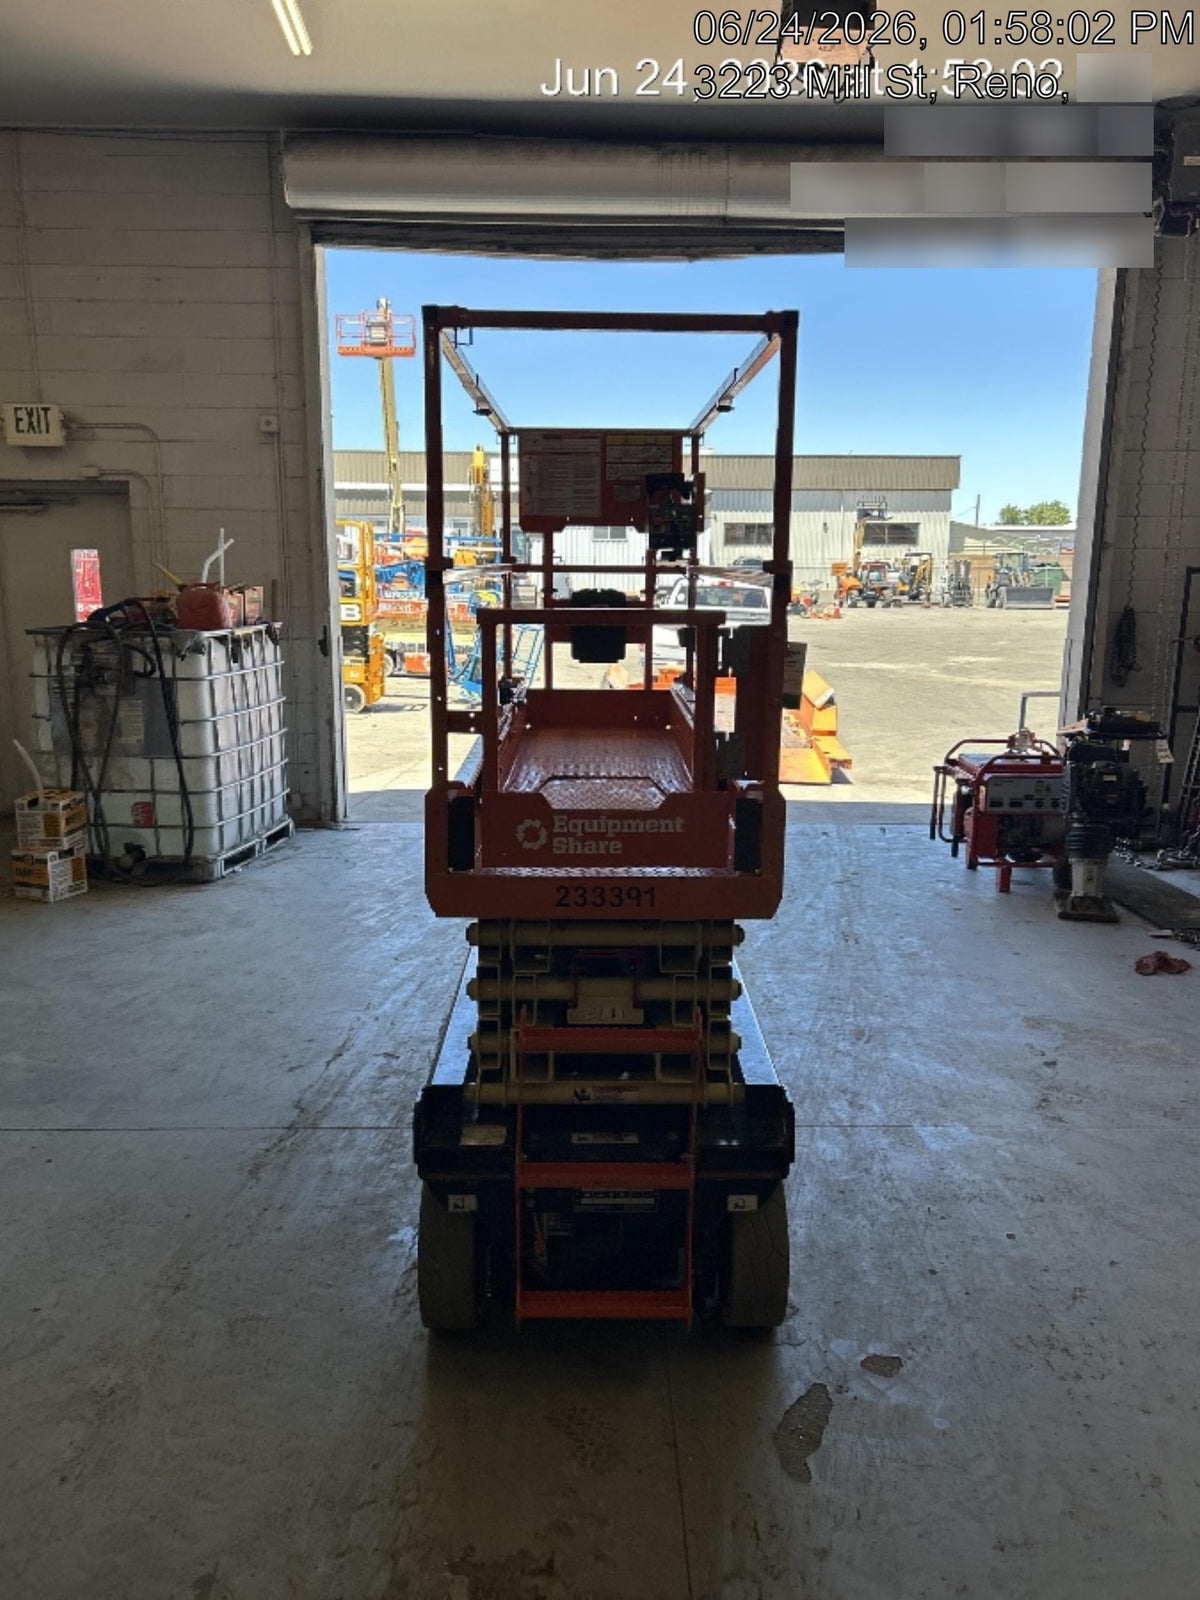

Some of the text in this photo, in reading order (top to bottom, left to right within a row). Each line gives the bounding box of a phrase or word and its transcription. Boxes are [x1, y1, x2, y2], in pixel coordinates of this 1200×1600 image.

[13, 406, 51, 434] EXIT
[552, 815, 685, 837] Equipment
[552, 837, 624, 854] Share
[555, 885, 656, 909] 233391
